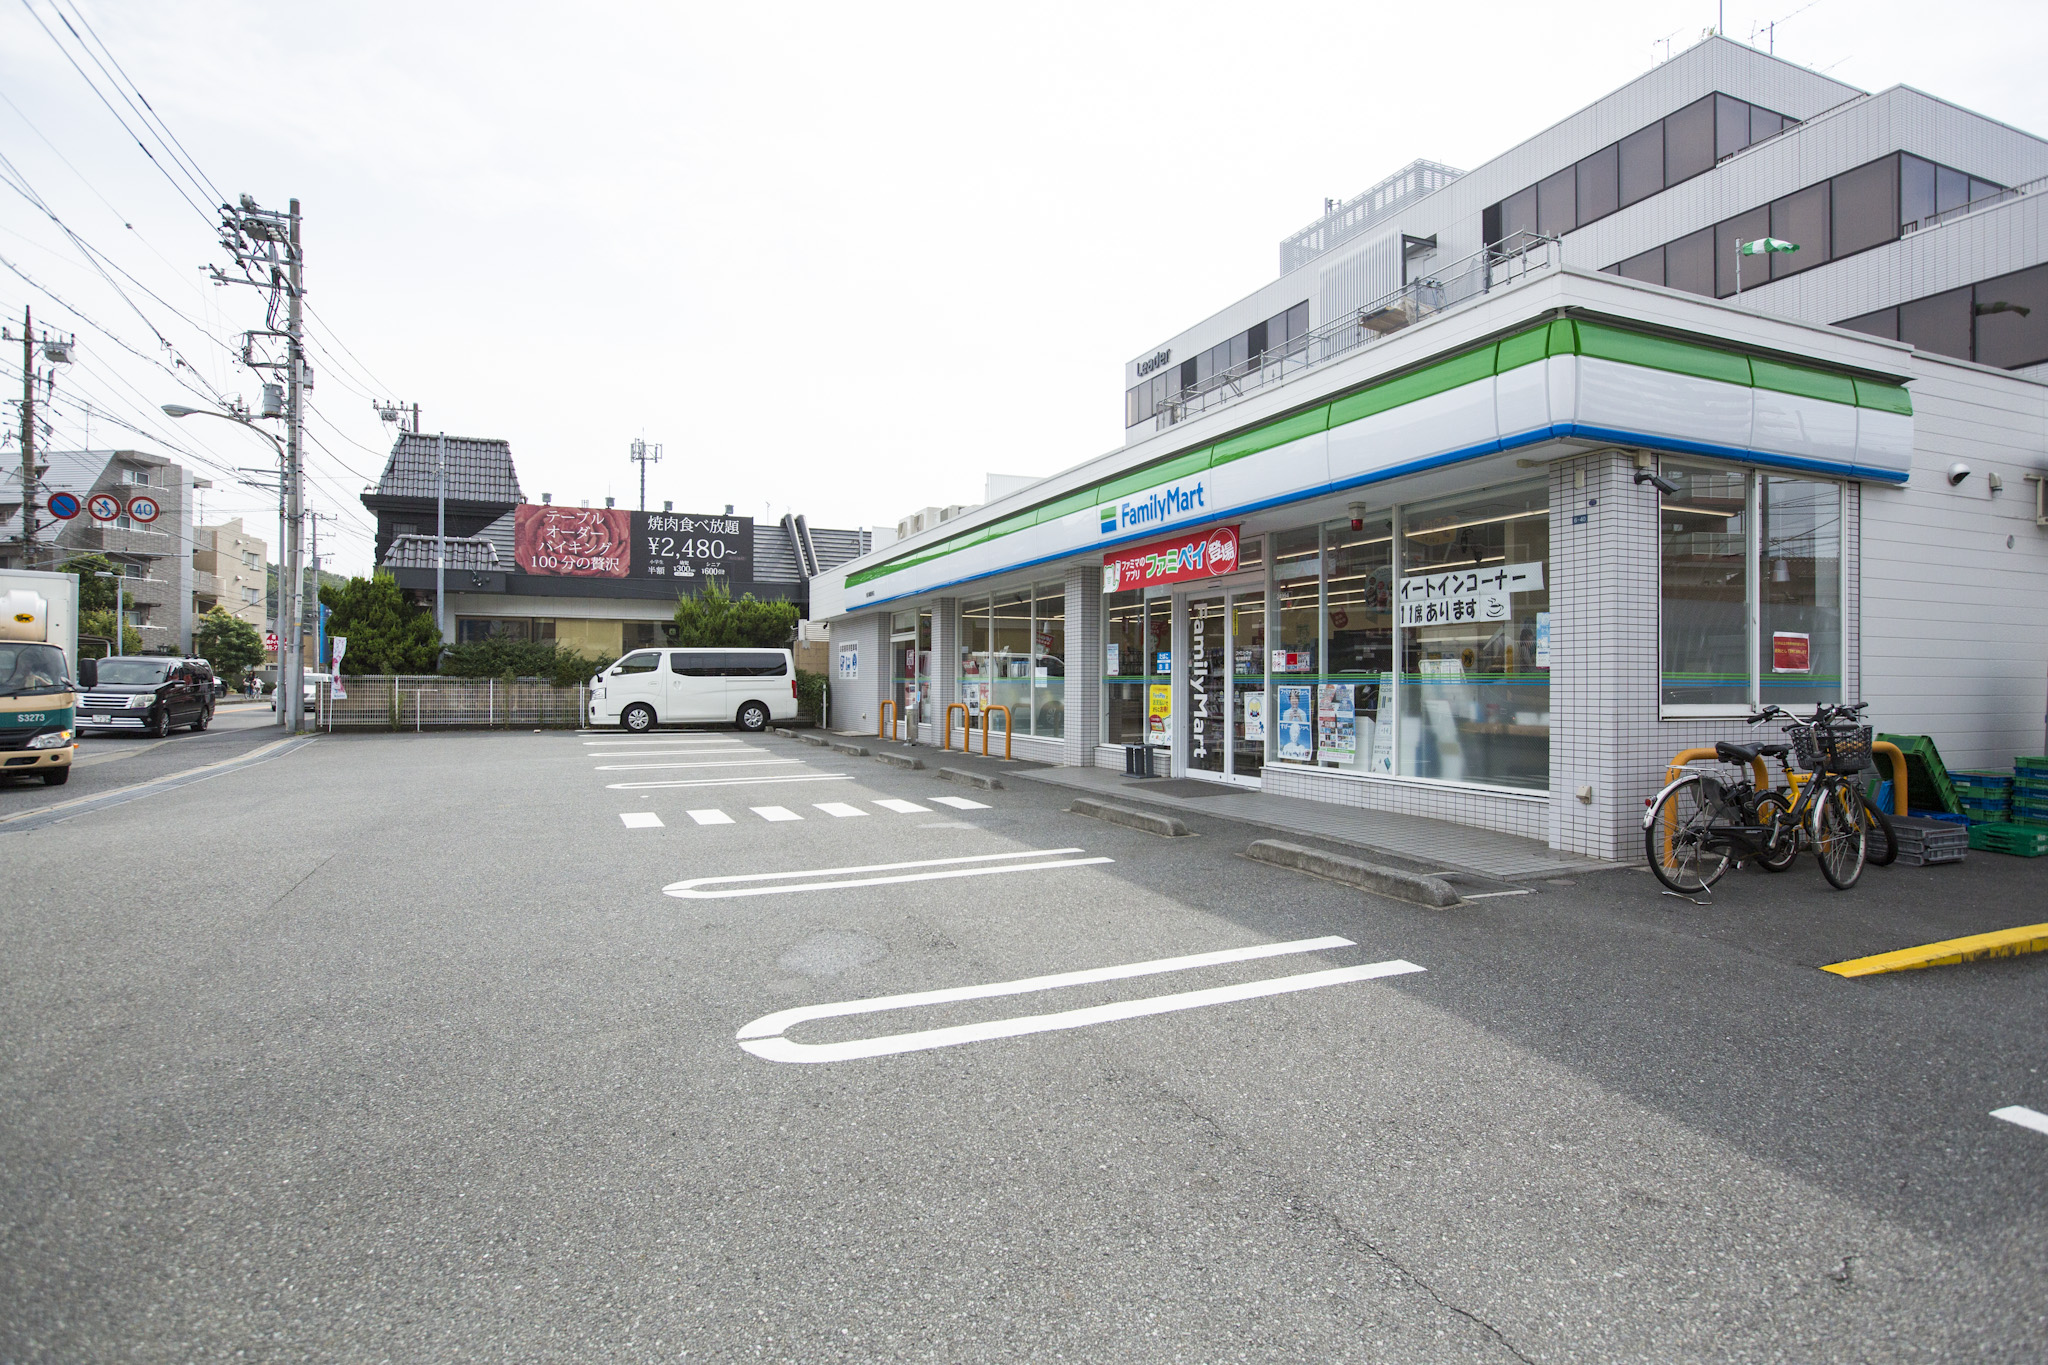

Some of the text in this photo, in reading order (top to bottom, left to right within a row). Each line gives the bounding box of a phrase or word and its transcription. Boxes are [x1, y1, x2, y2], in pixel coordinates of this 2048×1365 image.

[1137, 348, 1171, 377] Leader
[134, 503, 153, 516] 40
[1121, 481, 1205, 529] FamilyMart
[546, 510, 605, 525] テーブル
[647, 515, 740, 534] 焼肉食べ放題
[546, 525, 604, 540] オーダー
[538, 541, 613, 556] バイキング
[1207, 540, 1235, 565] 登場
[1121, 557, 1146, 571] ファミマの
[1145, 540, 1207, 579] ファミペイ
[648, 566, 665, 575] 半額
[1125, 569, 1141, 582] アプリ
[1401, 568, 1527, 600] イートインコーナー
[1190, 603, 1208, 759] FamilyMart
[18, 714, 46, 722] S3273
